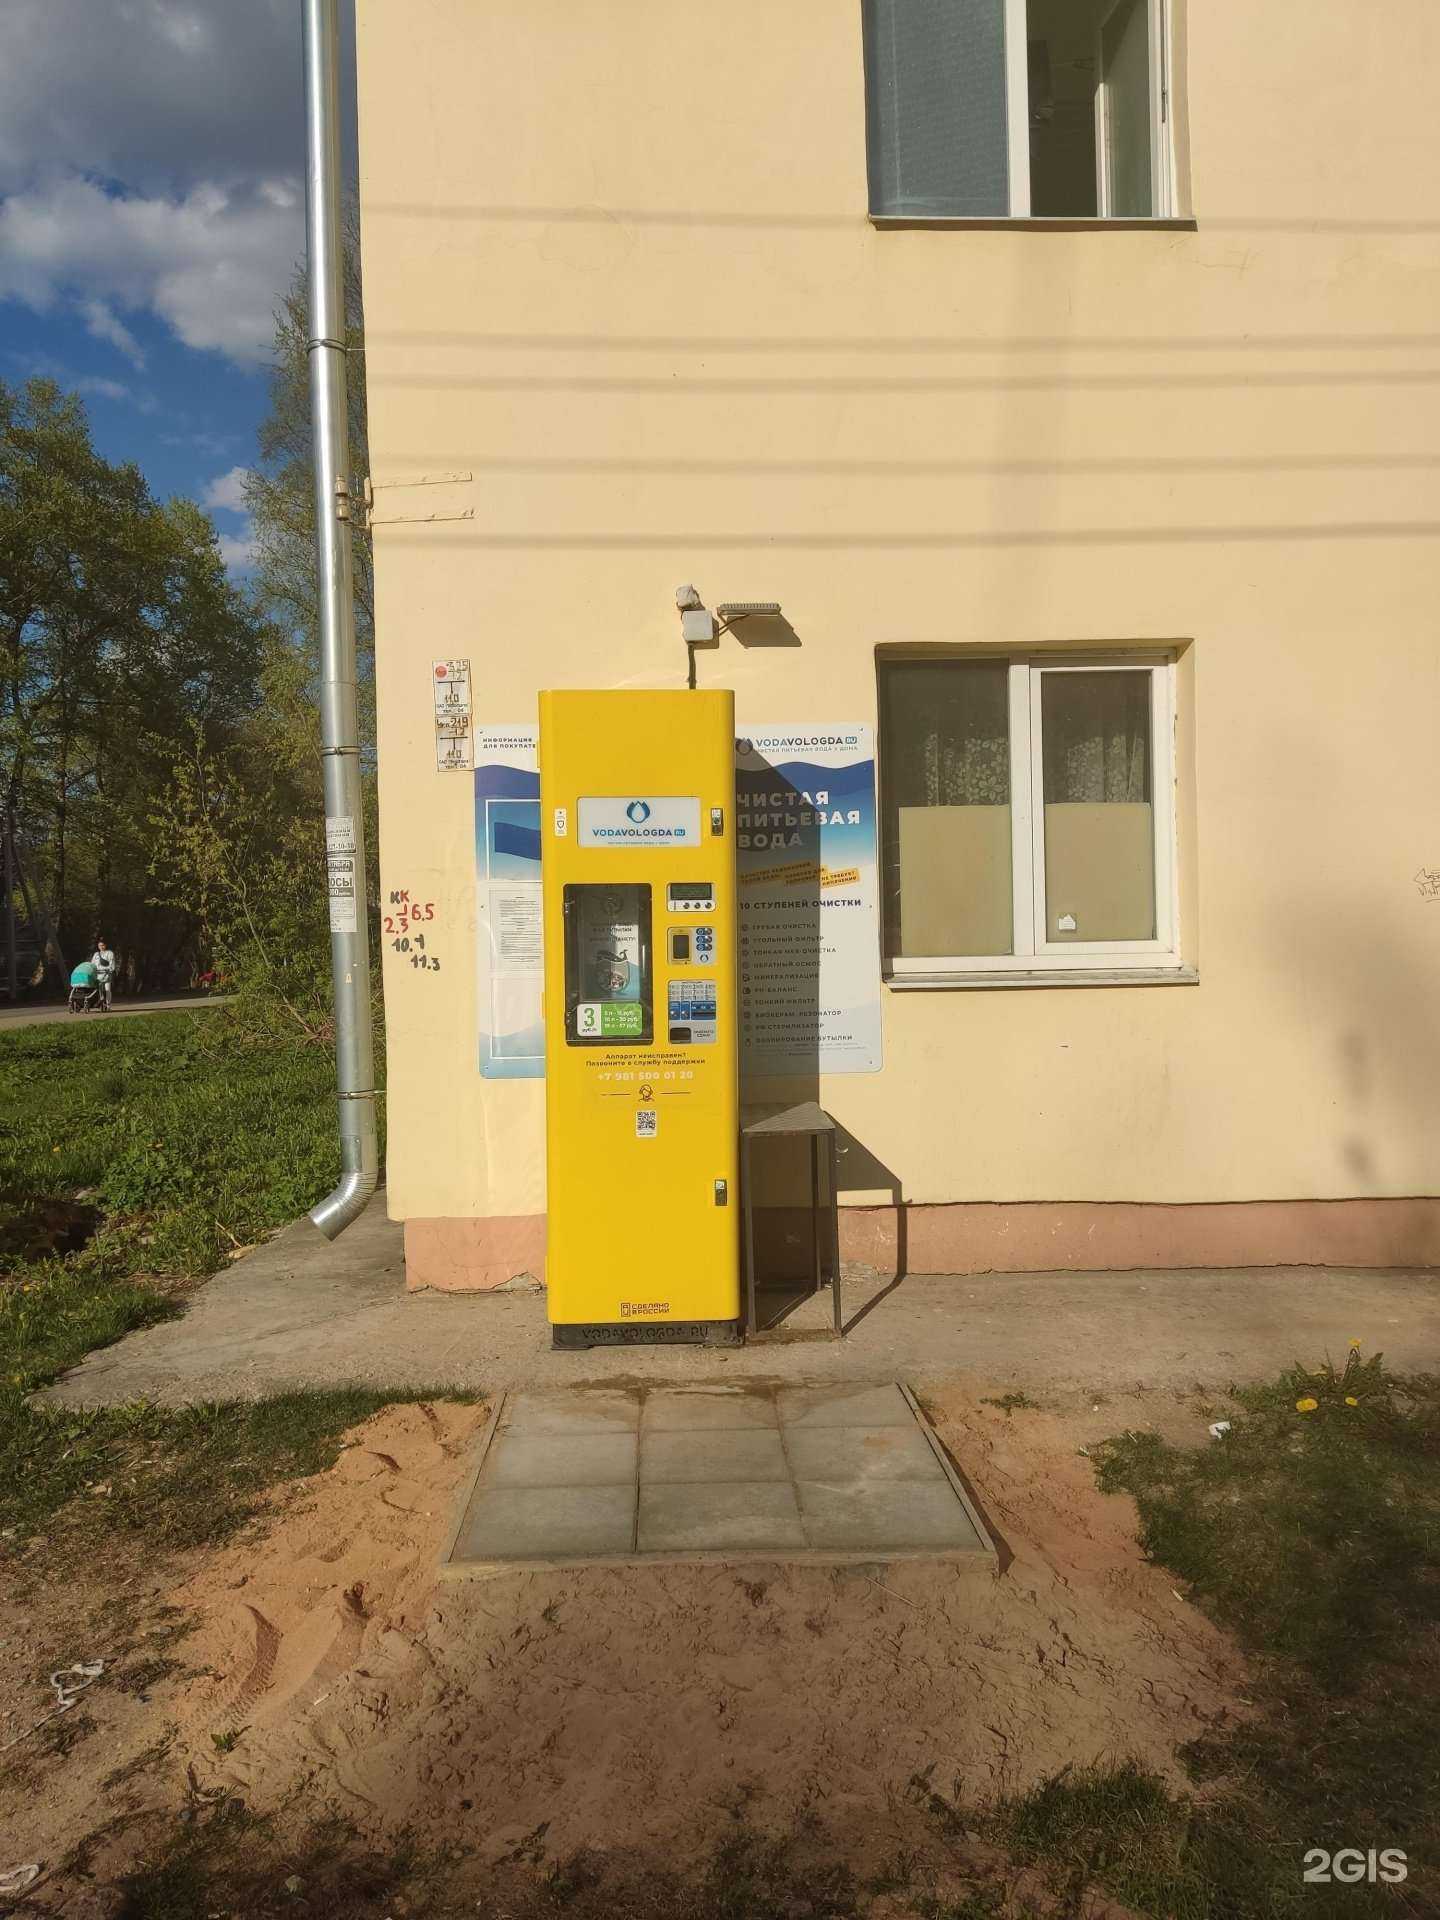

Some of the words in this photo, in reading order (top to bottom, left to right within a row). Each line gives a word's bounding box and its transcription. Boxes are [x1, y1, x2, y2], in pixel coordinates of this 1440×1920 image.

[756, 736, 844, 747] VODAVOLOGDA
[736, 790, 829, 808] ЧИСТАЯ
[737, 810, 861, 828] ПИТЬЕВАЯ
[592, 828, 673, 837] VODAVOLOGDA
[738, 832, 803, 849] ВОДА
[753, 900, 809, 910] СТУПЕНЕЙ
[811, 898, 862, 908] ОЧИСТКИ
[583, 1007, 595, 1028] 3
[605, 1053, 636, 1061] Аппарат
[633, 1059, 661, 1067] службу
[663, 1058, 706, 1066] поддержки
[597, 1072, 612, 1081] +7
